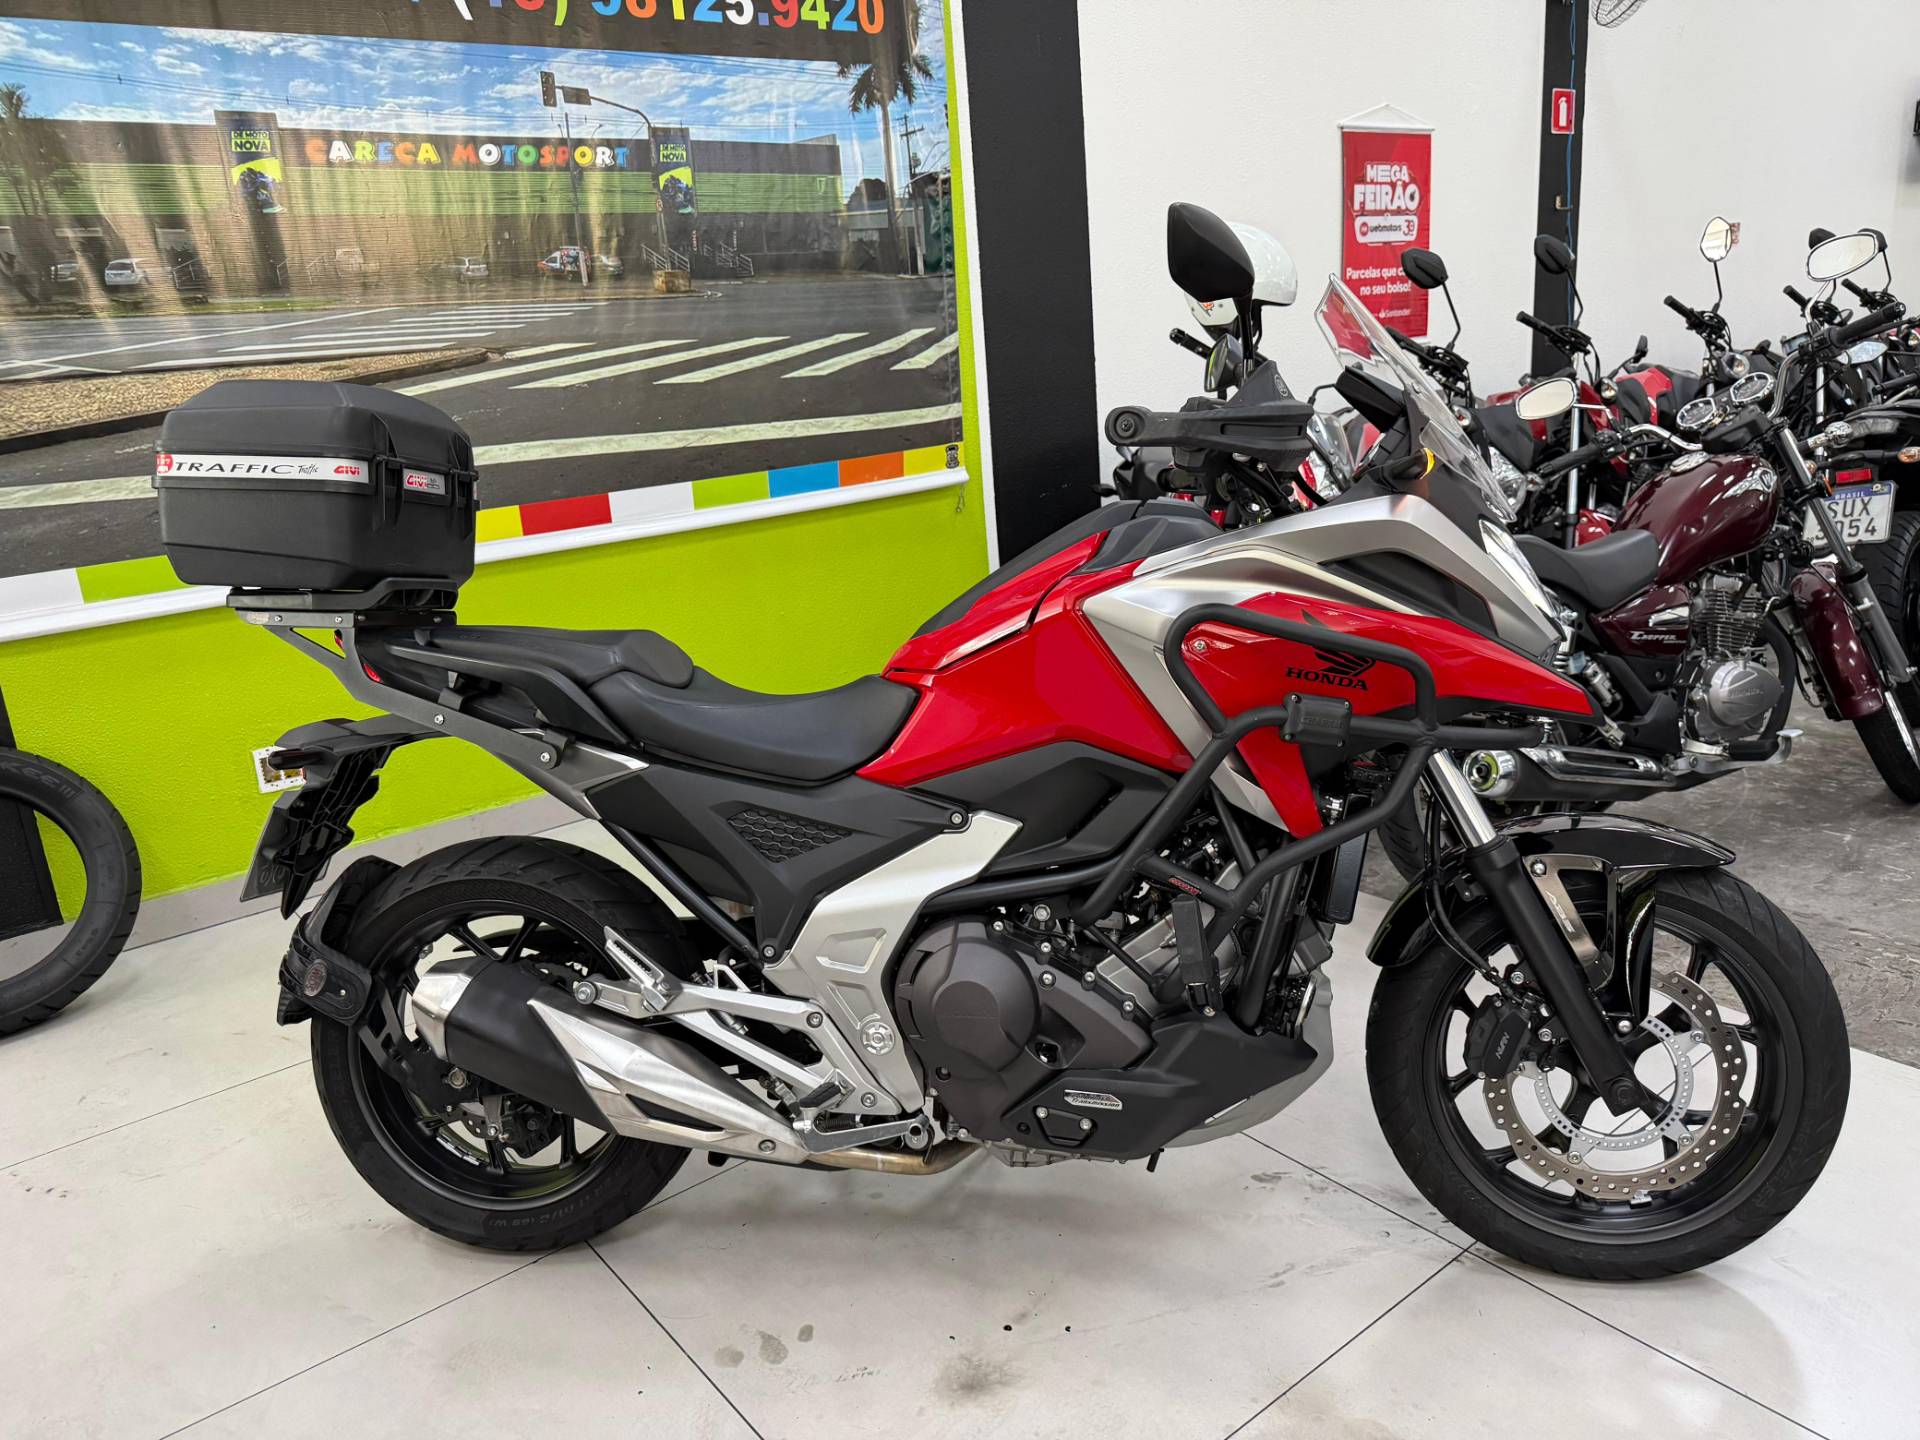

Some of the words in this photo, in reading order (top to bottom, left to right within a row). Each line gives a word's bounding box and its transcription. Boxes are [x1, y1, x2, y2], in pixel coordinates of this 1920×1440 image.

[234, 140, 269, 151] NOVA
[305, 139, 441, 164] CARECA
[452, 143, 629, 167] MOTOSPORT
[1366, 164, 1410, 182] MEGA
[1353, 181, 1420, 211] FEIRÃO
[1369, 224, 1402, 233] webmotors
[1346, 266, 1380, 280] Parcelas
[1381, 268, 1396, 280] que
[1360, 284, 1371, 295] no
[1372, 284, 1386, 294] seu
[1387, 281, 1411, 293] bolso!
[175, 461, 294, 475] TRAFFIC
[1834, 491, 1866, 500] BRASIL
[1827, 496, 1872, 519] SUX
[1286, 666, 1368, 691] HONDA
